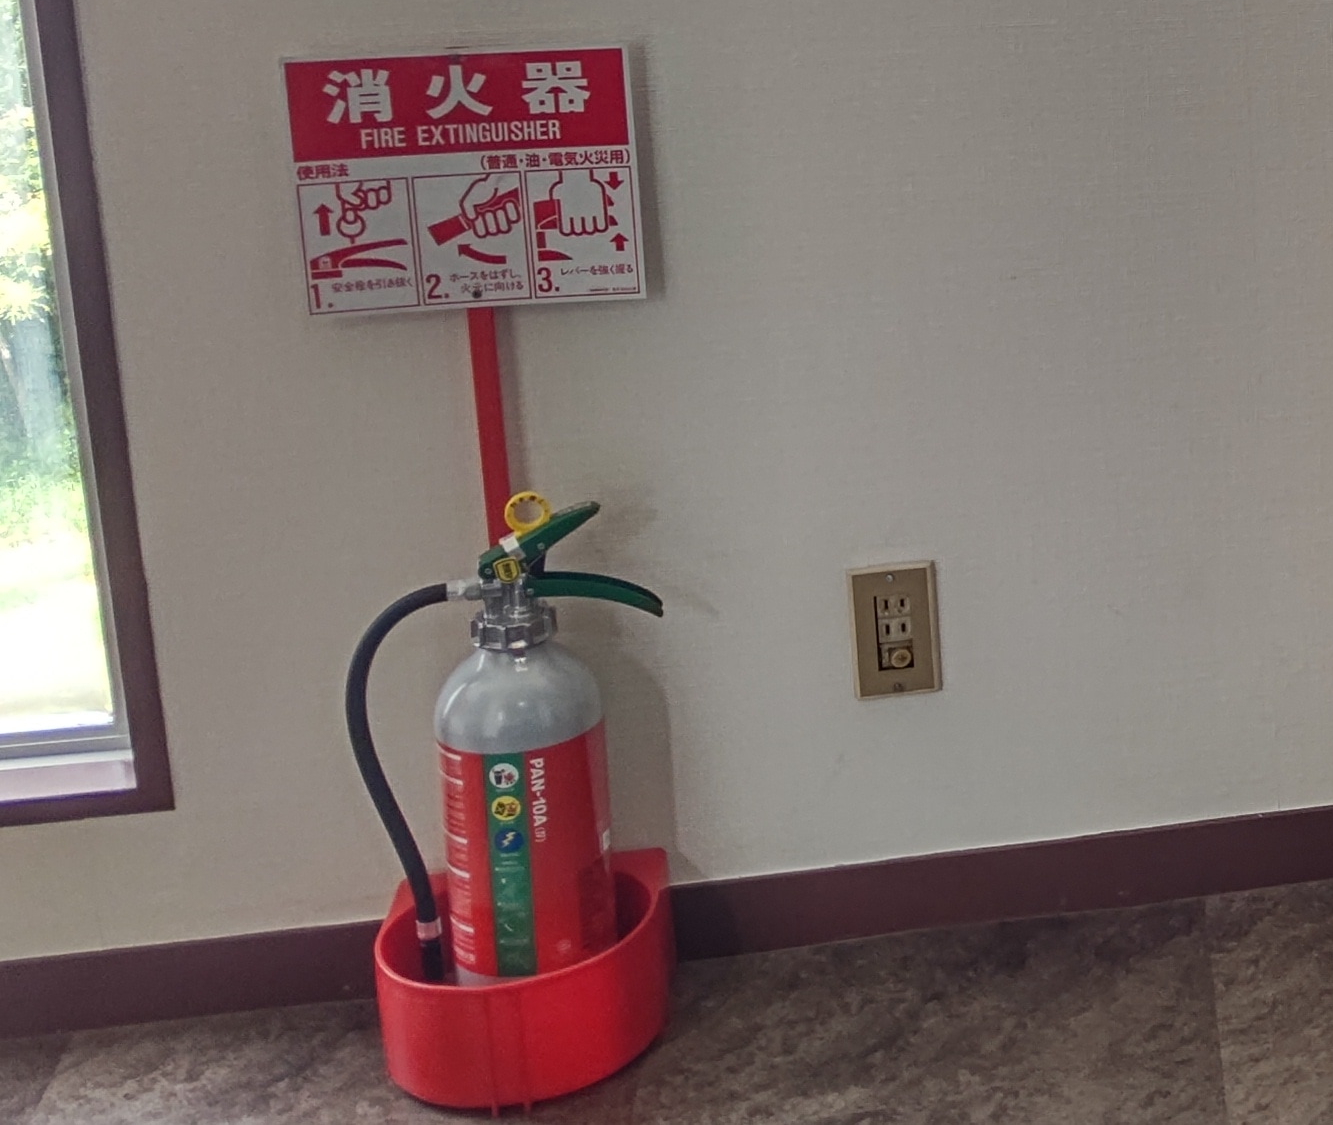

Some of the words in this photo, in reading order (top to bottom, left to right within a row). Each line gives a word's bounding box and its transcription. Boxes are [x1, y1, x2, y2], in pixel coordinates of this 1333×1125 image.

[322, 60, 591, 125] 消火器
[360, 126, 406, 150] FIRE
[417, 120, 561, 146] EXTINGUISHER
[296, 163, 350, 180] 使用法
